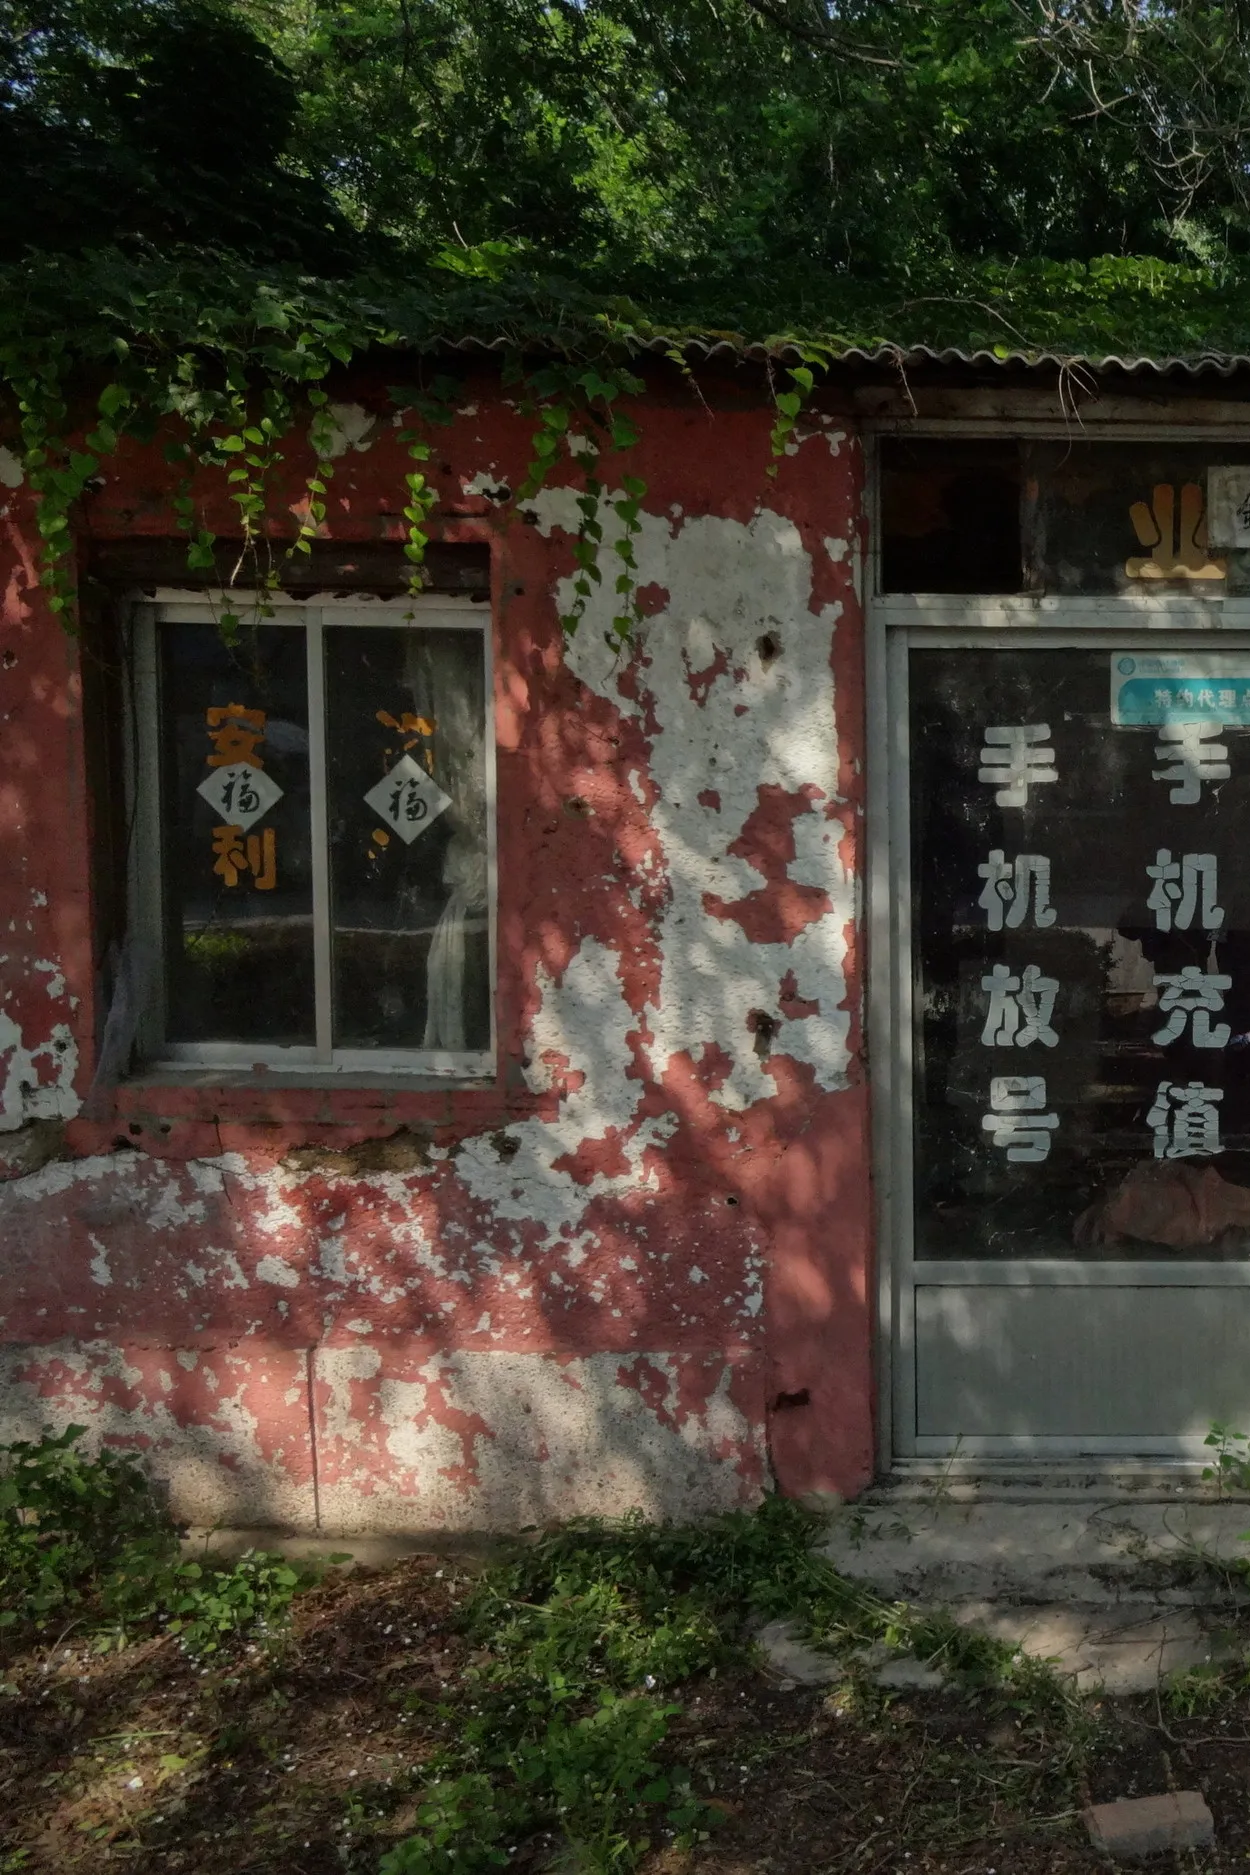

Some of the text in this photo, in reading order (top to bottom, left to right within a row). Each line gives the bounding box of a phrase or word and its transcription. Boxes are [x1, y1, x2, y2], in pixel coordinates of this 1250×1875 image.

[978, 723, 1060, 1162] 手机放号
[1146, 721, 1232, 1159] 手机充值
